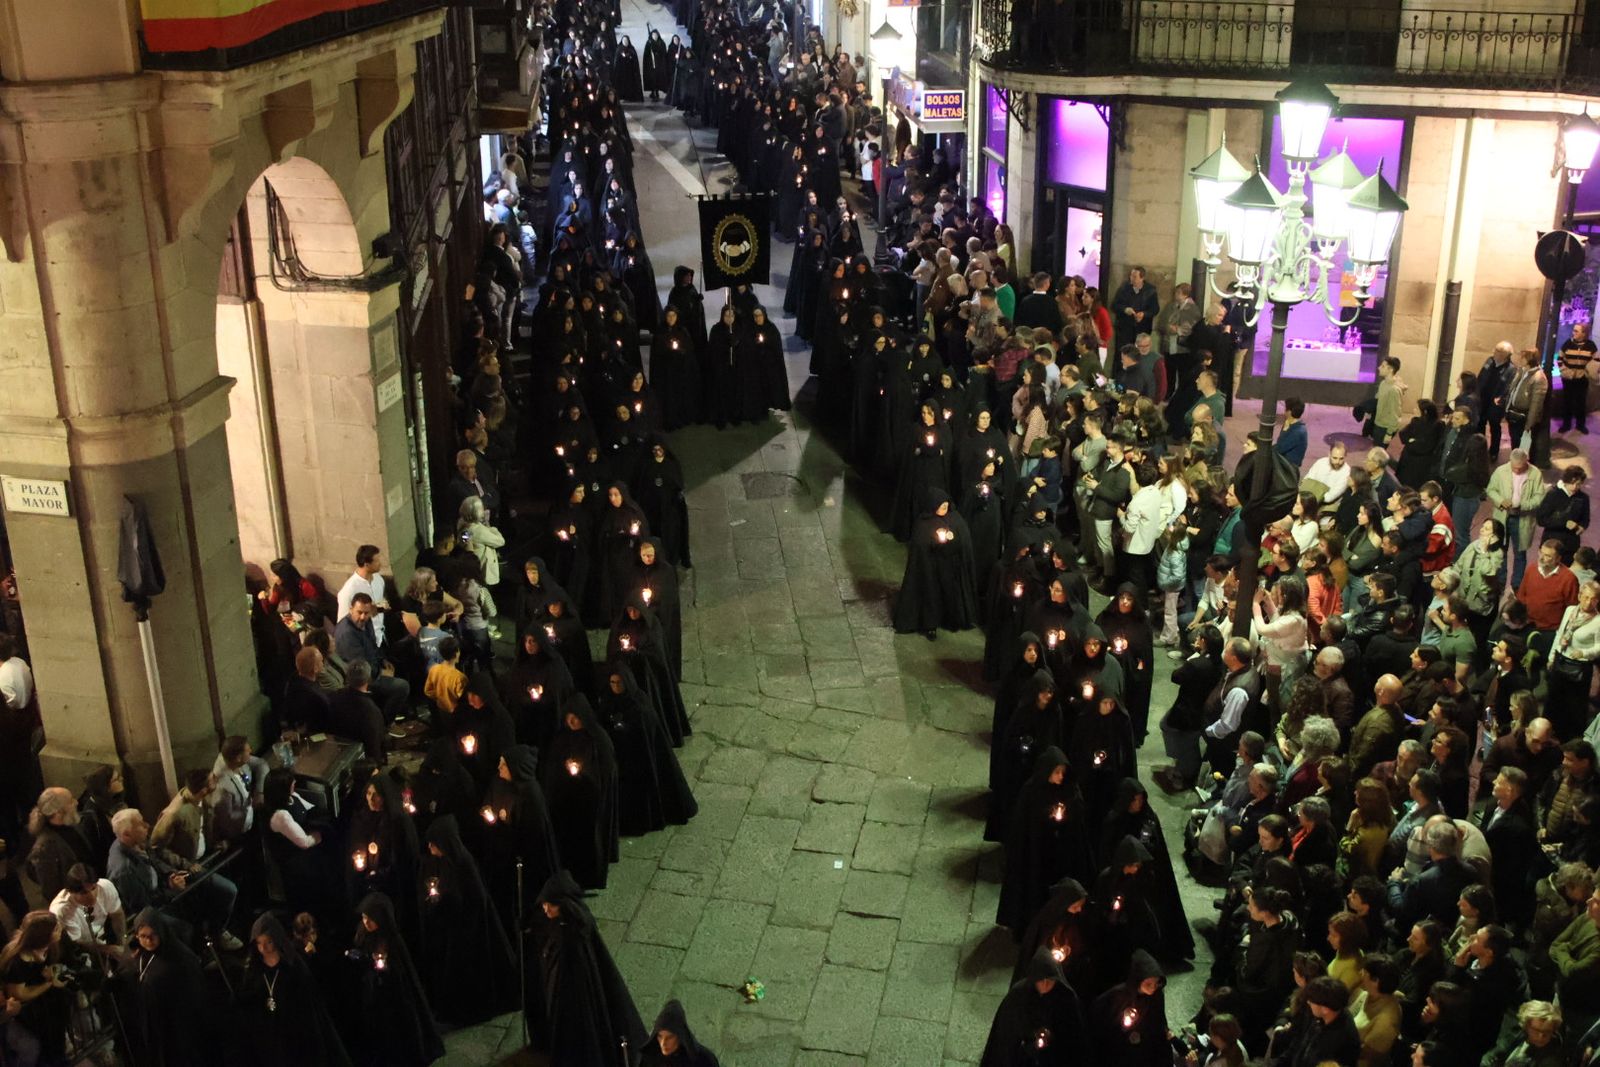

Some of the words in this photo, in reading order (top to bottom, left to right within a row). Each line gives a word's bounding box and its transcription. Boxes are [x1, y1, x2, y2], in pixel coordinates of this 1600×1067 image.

[926, 95, 960, 105] BOLSOS
[924, 107, 961, 117] MALETAS
[21, 484, 59, 496] PLAZA
[22, 497, 63, 510] MAYOR
